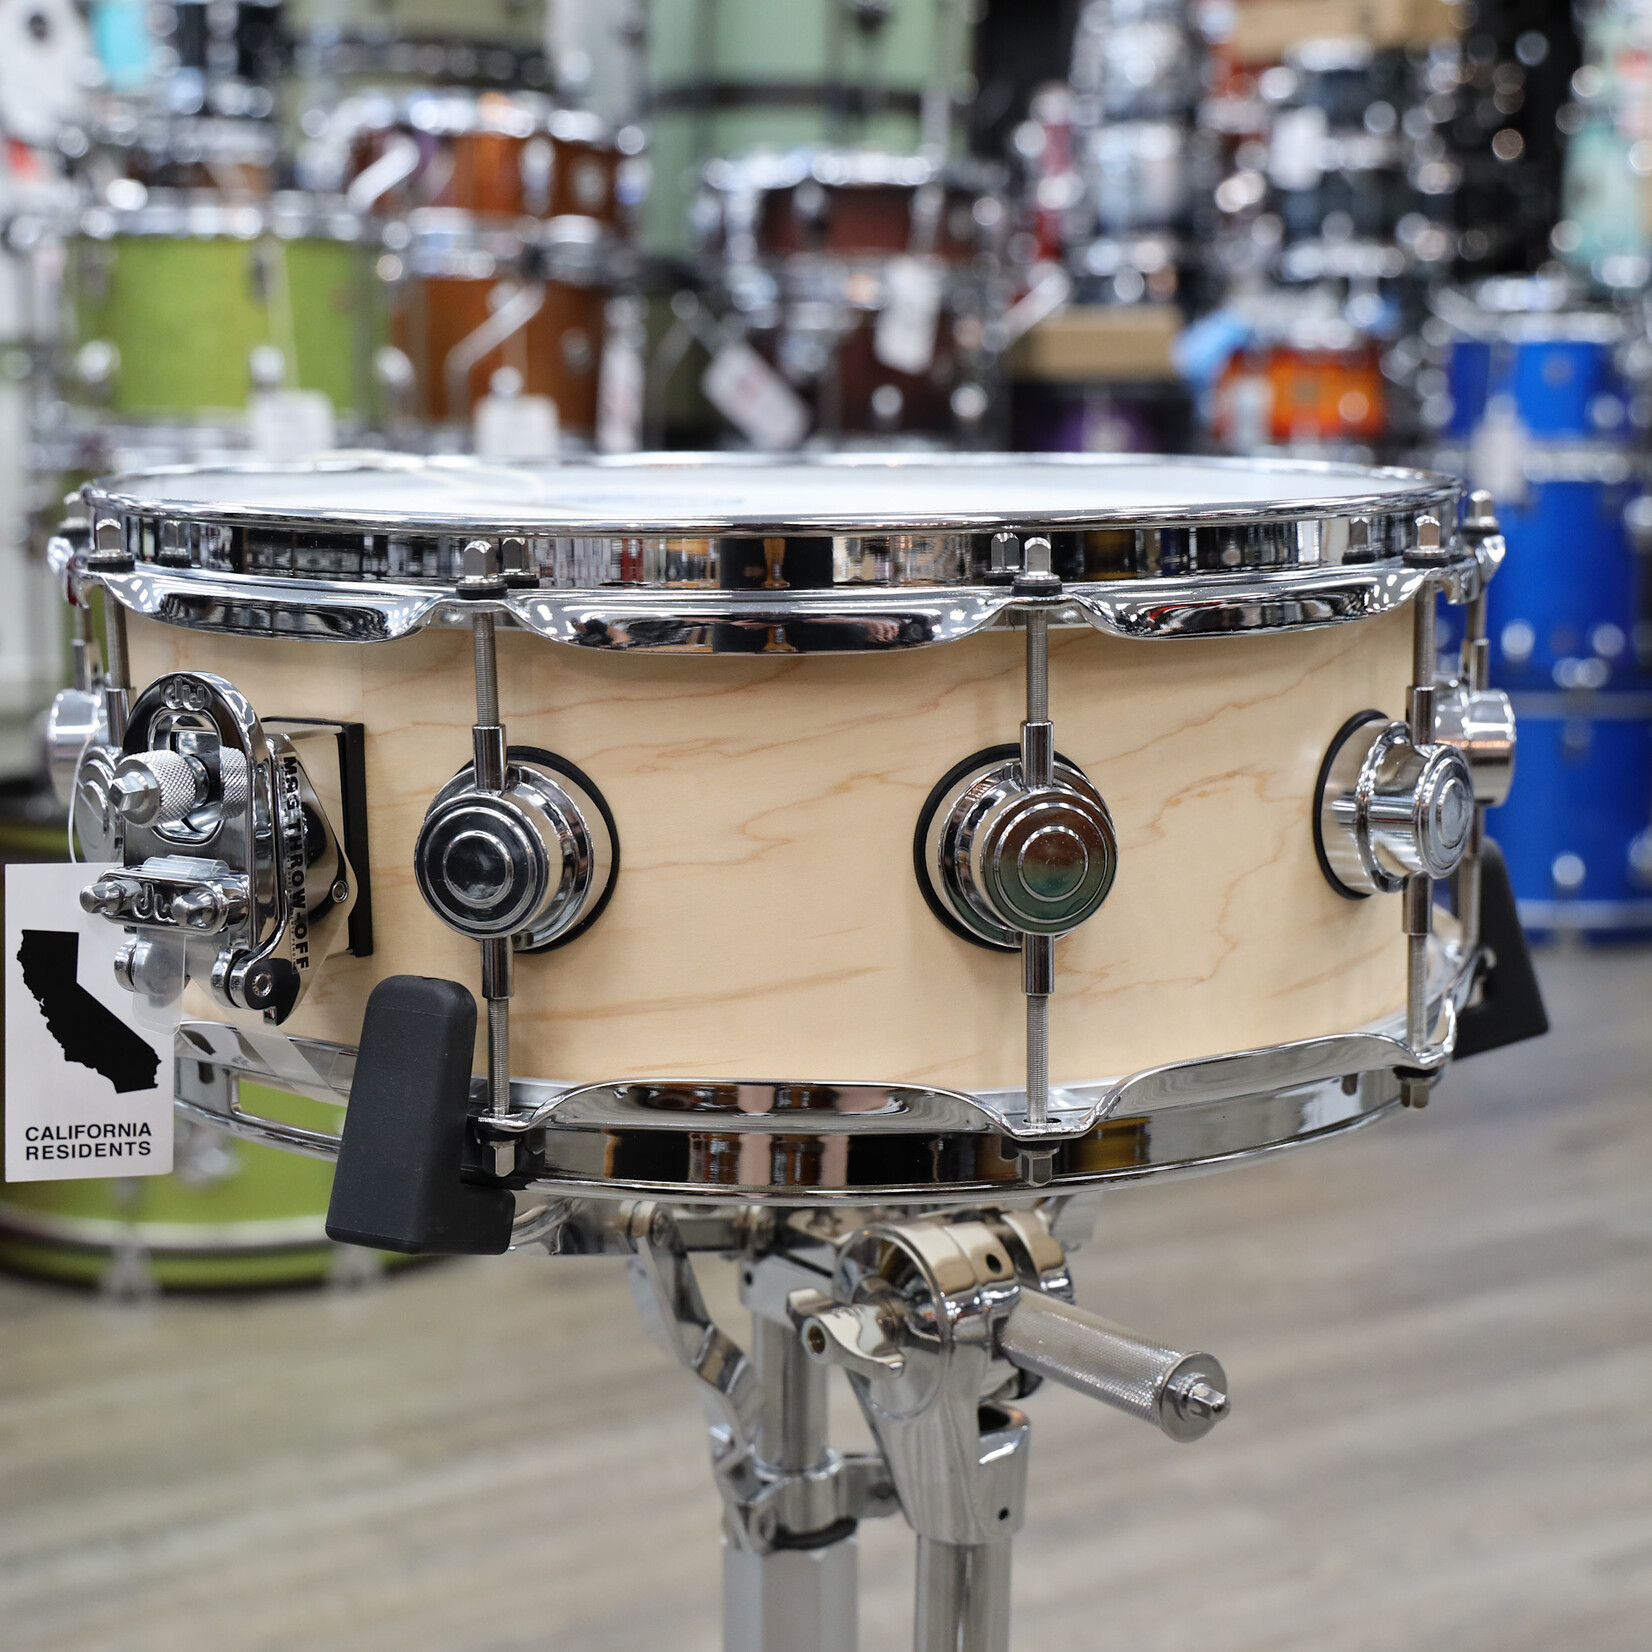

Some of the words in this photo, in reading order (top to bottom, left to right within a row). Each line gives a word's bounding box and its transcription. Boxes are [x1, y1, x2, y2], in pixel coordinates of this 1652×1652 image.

[283, 756, 299, 811] MAG
[288, 818, 309, 969] THROW-OFF
[25, 1122, 152, 1142] CALIFORNIA
[25, 1141, 151, 1161] RESIDENTS
